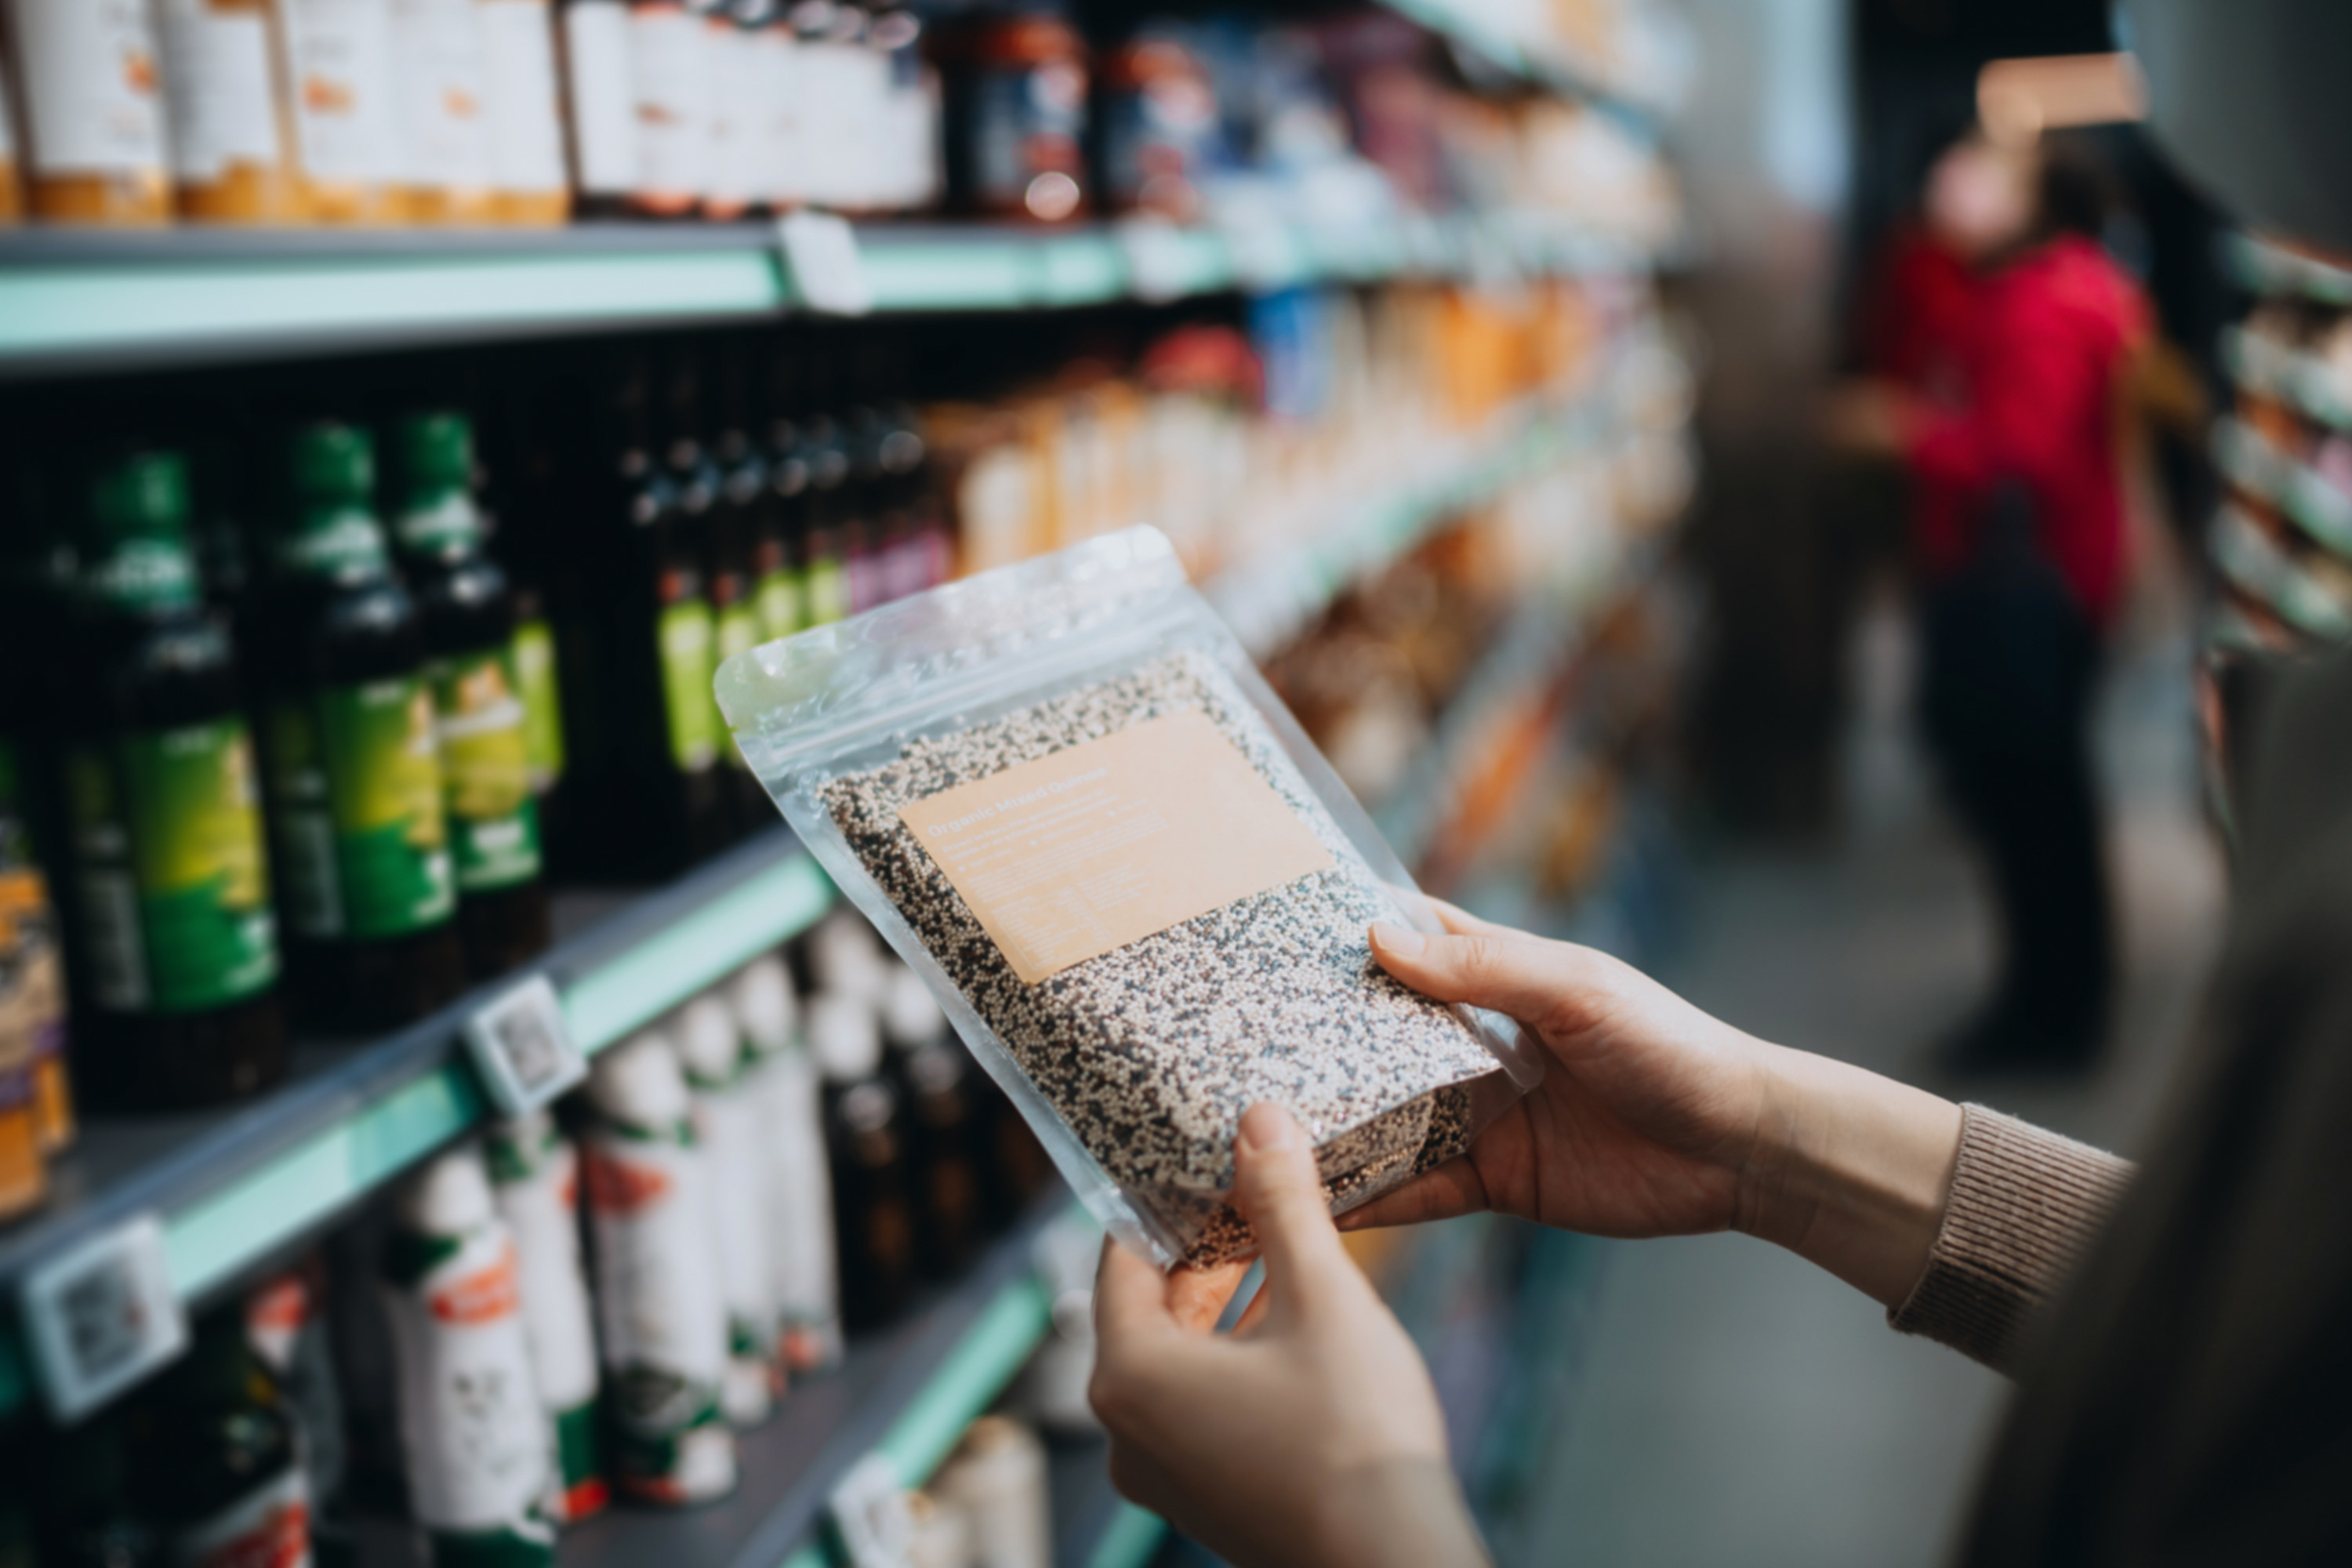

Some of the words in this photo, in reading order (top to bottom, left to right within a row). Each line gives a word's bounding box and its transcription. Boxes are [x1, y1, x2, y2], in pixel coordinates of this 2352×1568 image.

[927, 805, 996, 837] Organic
[995, 786, 1048, 814] Mixed
[1047, 767, 1109, 794] Quinoa
